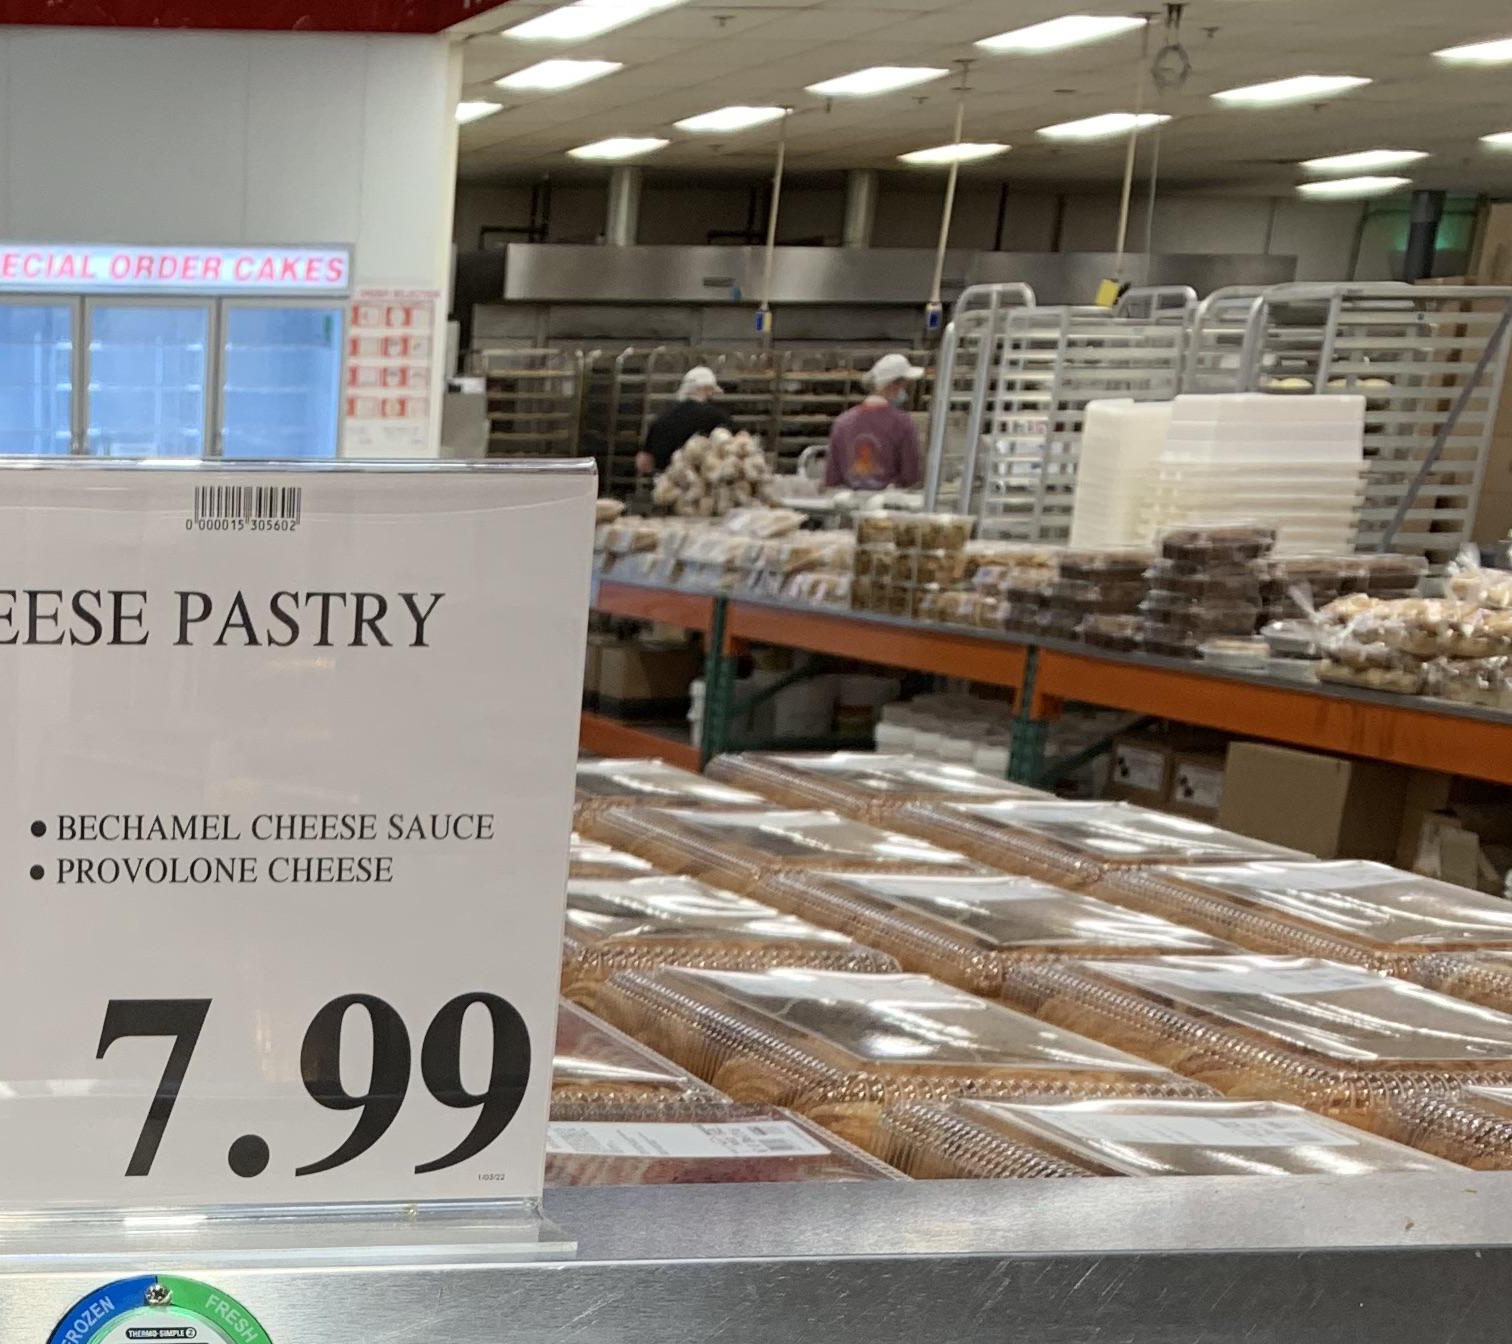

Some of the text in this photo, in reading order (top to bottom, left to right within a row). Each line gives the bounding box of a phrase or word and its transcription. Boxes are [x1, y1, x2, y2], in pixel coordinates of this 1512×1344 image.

[111, 255, 221, 280] ORDER
[235, 256, 343, 281] CAKES
[174, 592, 445, 649] PASTRY
[57, 814, 495, 842] BECHAMEL CHEESE SAUCE
[57, 857, 394, 885] PROVOLONE CHEESE
[94, 992, 532, 1179] 7.99
[205, 1294, 258, 1343] FRESH
